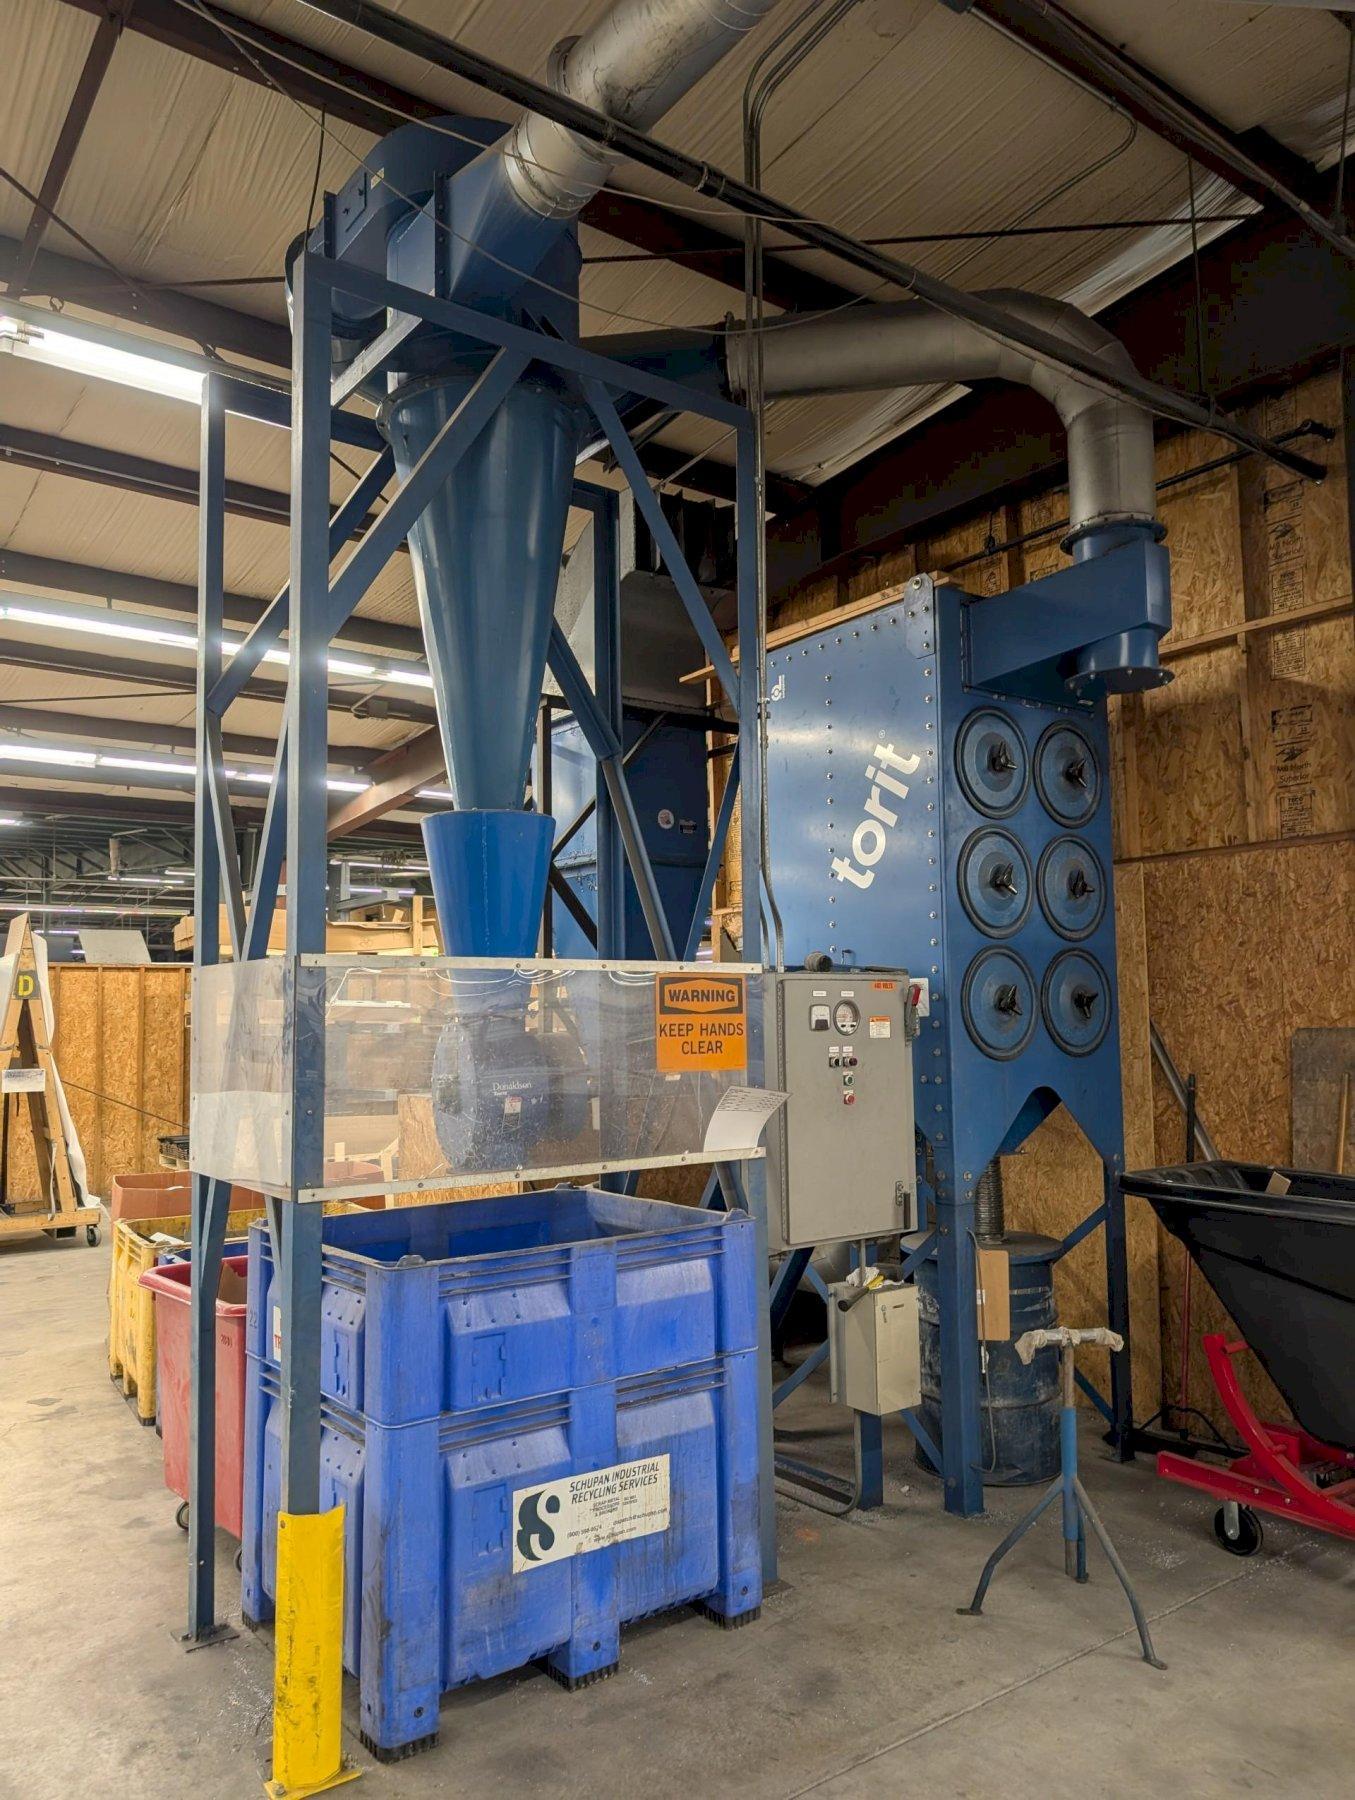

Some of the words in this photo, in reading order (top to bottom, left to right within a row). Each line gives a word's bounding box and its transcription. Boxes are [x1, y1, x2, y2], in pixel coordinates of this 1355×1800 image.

[831, 743, 921, 889] torit
[18, 975, 34, 996] D
[668, 989, 736, 1002] WARNING
[659, 1023, 694, 1037] KEEP
[700, 1022, 744, 1037] HANDS
[681, 1040, 723, 1055] CLEAR
[493, 1081, 532, 1091] Donaldson
[569, 1474, 610, 1493] SCHUPAN
[612, 1462, 660, 1481] INDUSTRIAL
[571, 1484, 617, 1505] RECYCLING
[618, 1473, 658, 1492] SERVICES
